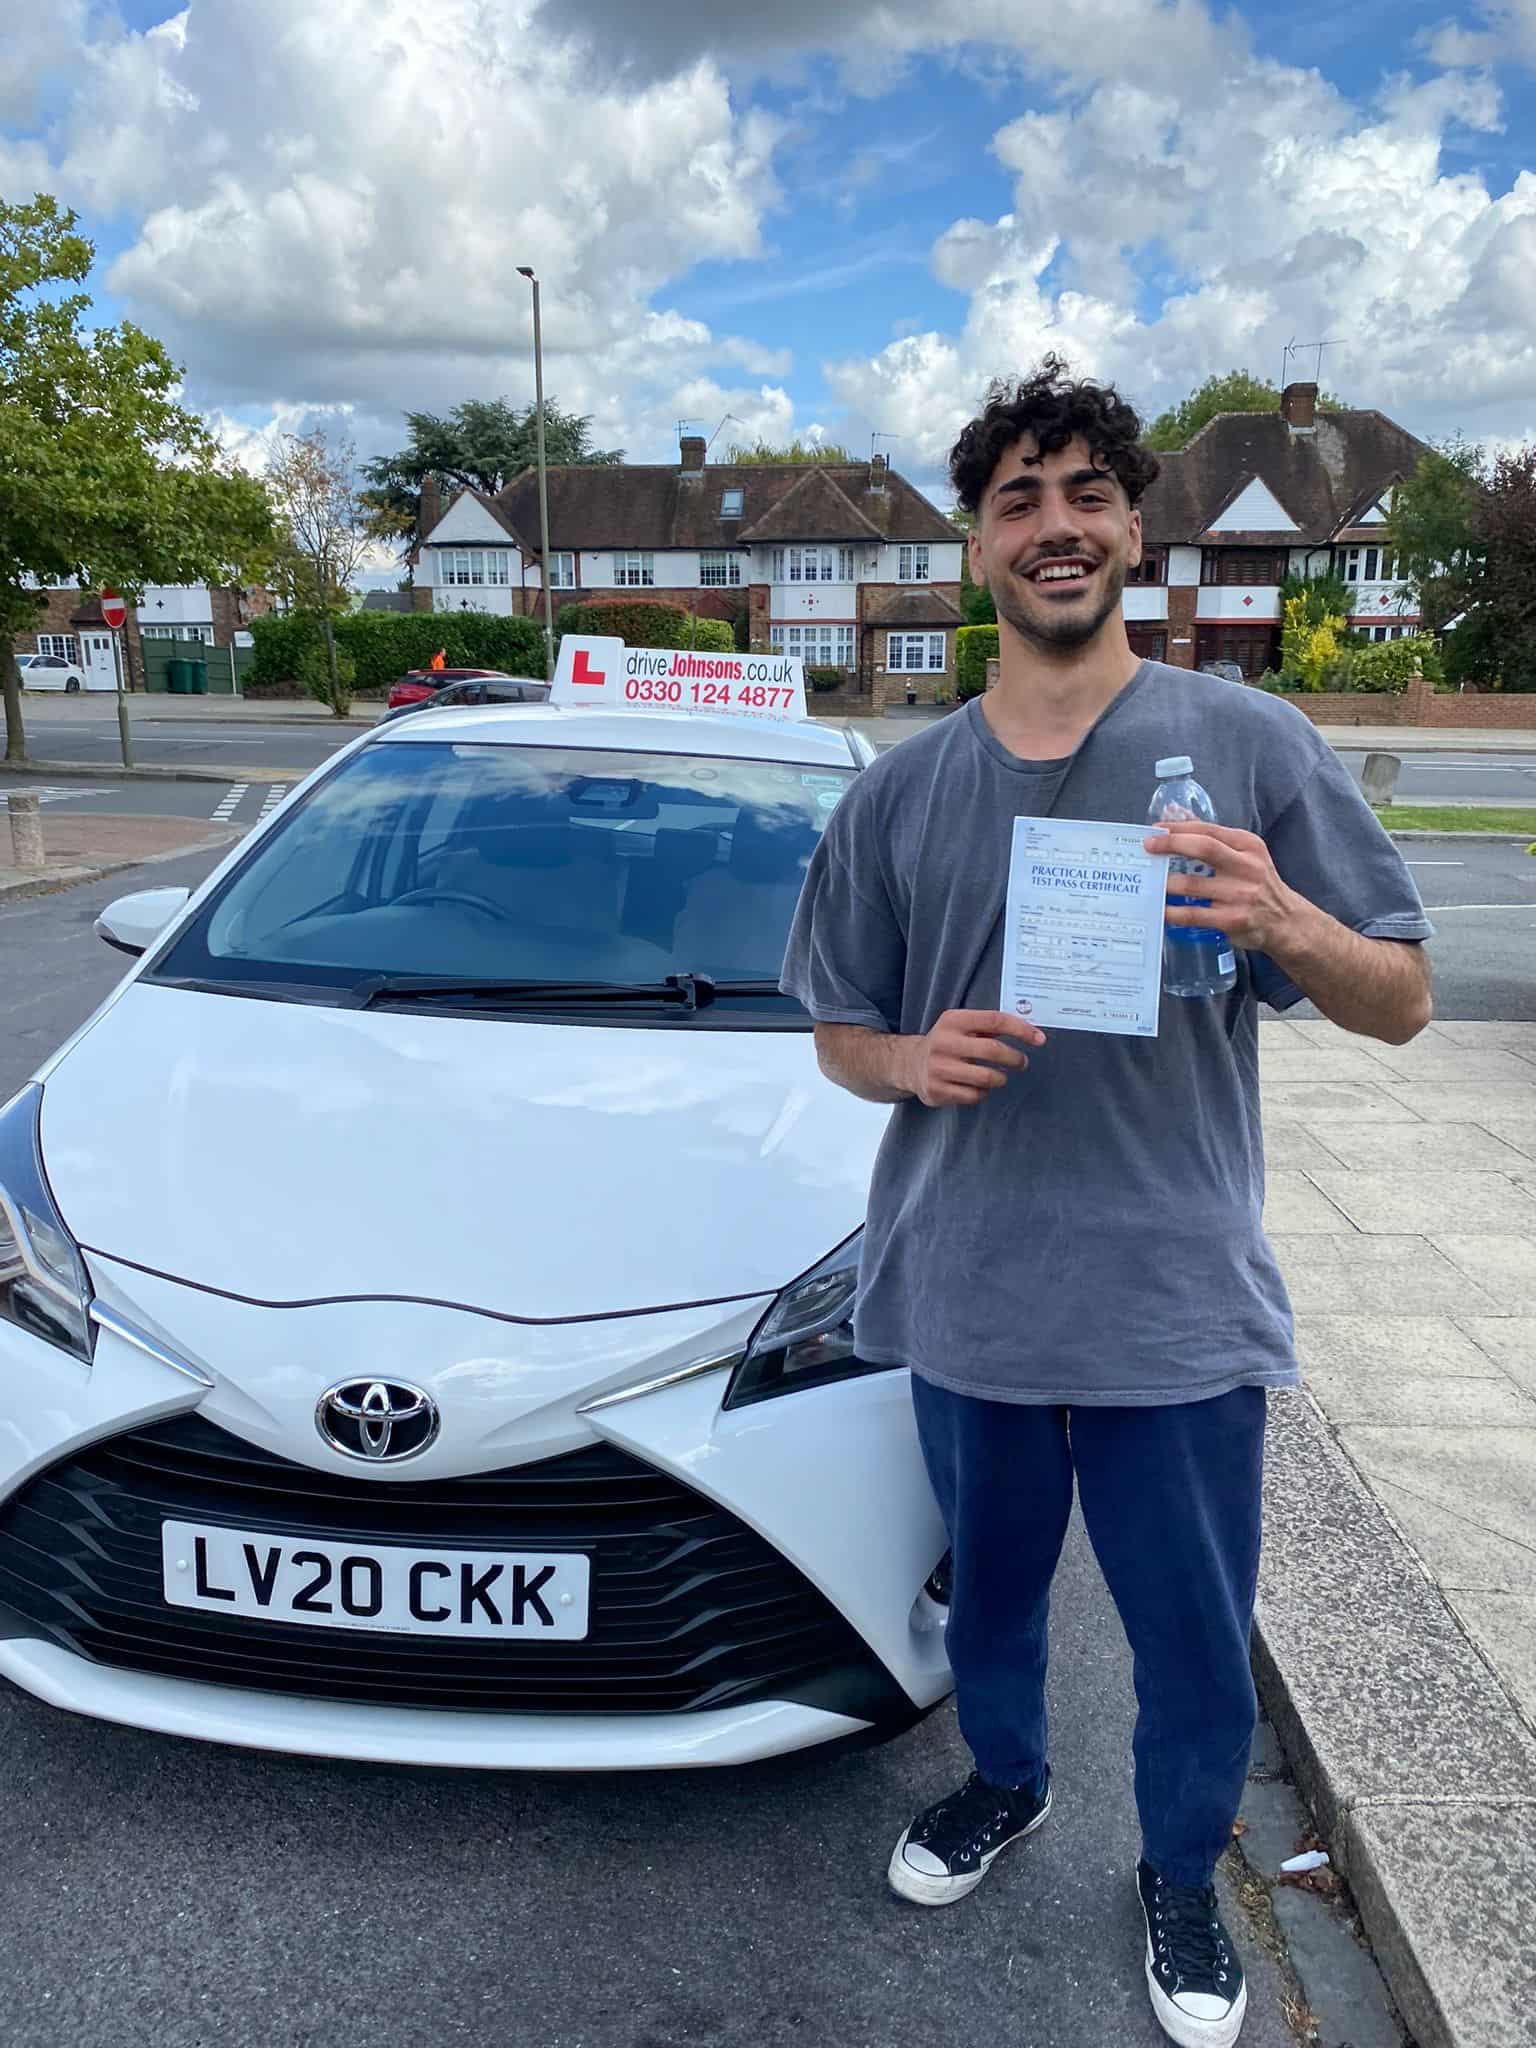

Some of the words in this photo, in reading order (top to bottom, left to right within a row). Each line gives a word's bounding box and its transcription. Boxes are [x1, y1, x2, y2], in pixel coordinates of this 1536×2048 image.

[572, 651, 606, 685] L
[626, 651, 793, 683] driveJohnsons.co.uk
[625, 679, 682, 702] 0330
[690, 685, 731, 705] 124
[738, 686, 795, 709] 4877
[1031, 865, 1089, 879] PRACTICAL
[1092, 870, 1142, 884] DRIVING
[1032, 876, 1052, 887] TEST
[1055, 879, 1077, 889] PASS
[1080, 880, 1140, 894] CERTIFICATE
[194, 1536, 384, 1618] LV20
[409, 1561, 556, 1627] CKK
